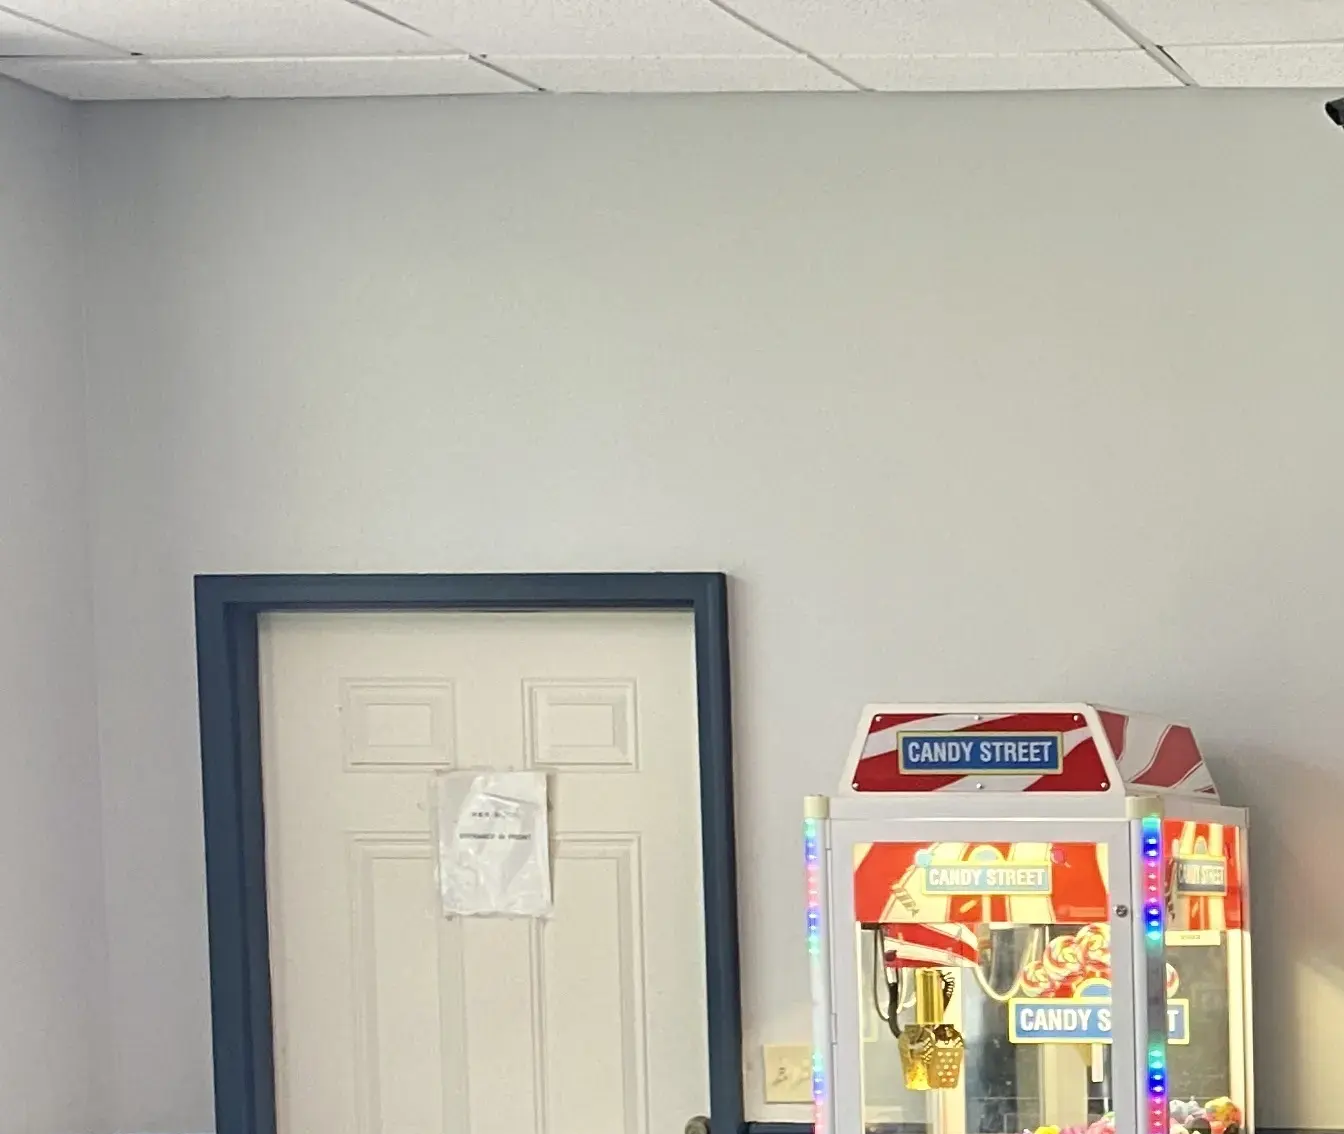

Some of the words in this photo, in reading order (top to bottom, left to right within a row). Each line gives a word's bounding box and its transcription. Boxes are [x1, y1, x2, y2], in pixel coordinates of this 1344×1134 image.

[908, 741, 973, 763] CANDY
[979, 740, 1053, 763] STREET
[929, 869, 982, 886] CANDY
[985, 867, 1046, 886] STREET
[1019, 1008, 1092, 1032] CANDY
